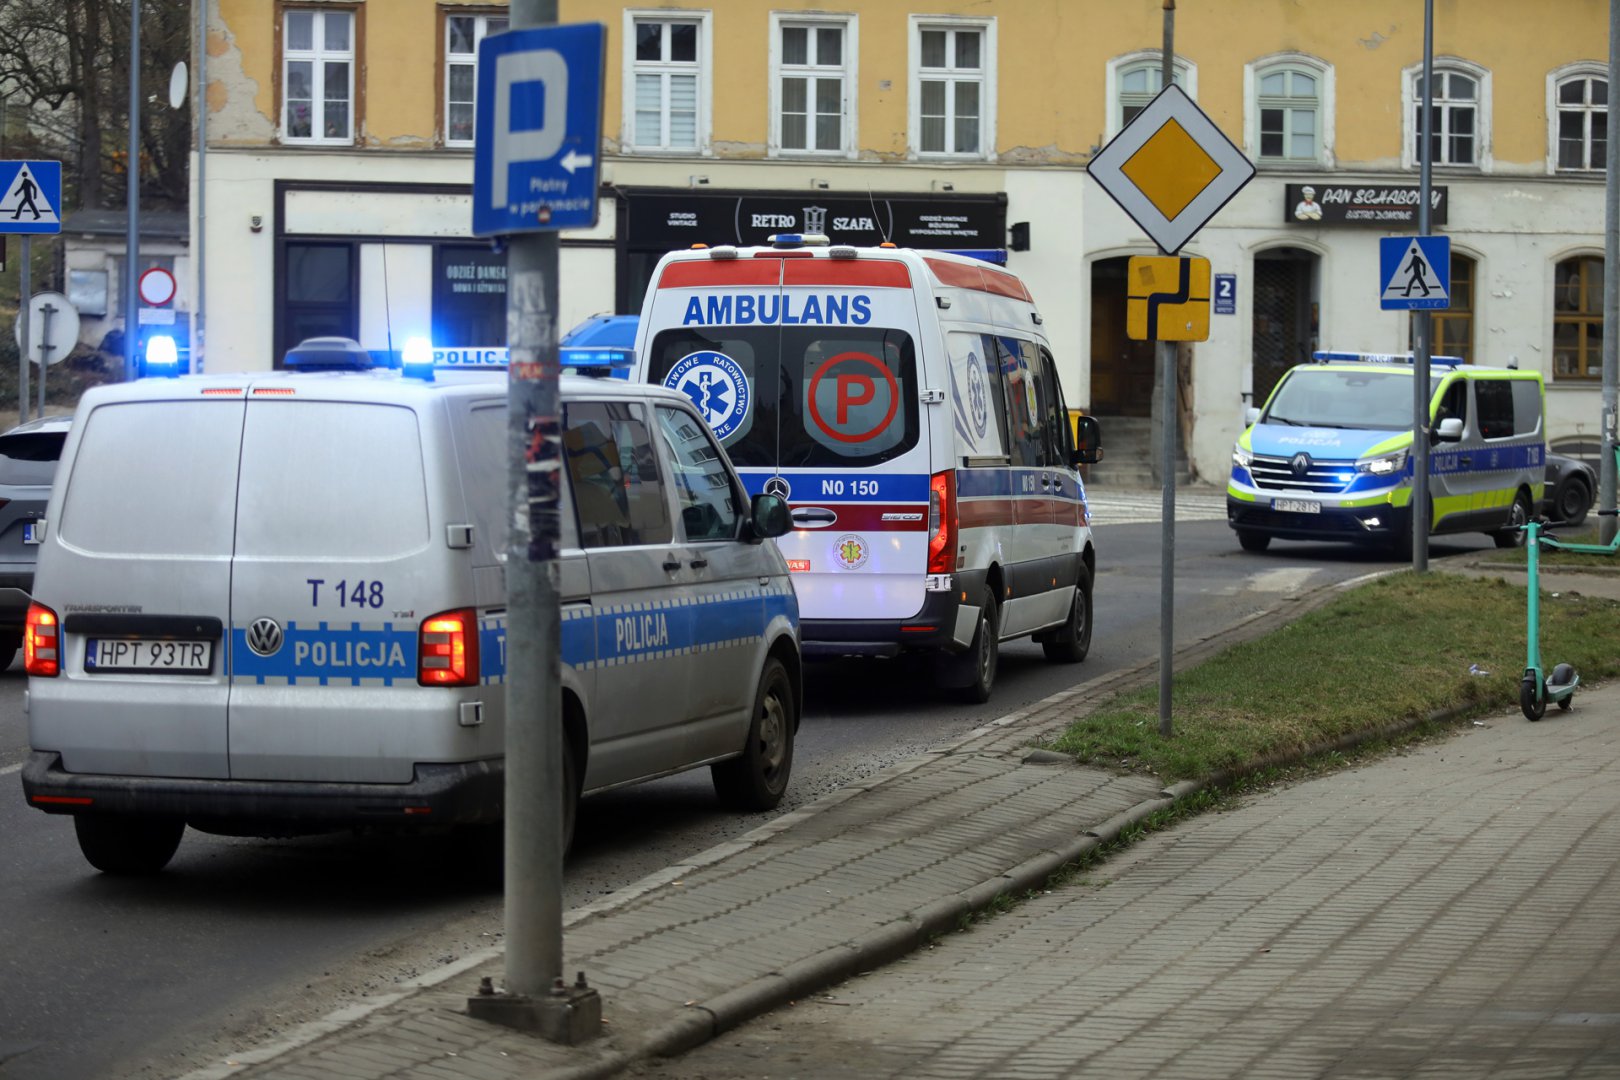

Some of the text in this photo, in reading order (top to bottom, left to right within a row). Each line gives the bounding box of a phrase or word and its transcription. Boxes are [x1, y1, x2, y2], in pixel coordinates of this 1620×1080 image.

[492, 49, 569, 209] P
[1322, 188, 1442, 210] PAN SCHABOY
[667, 219, 698, 227] VINTAGE
[751, 214, 796, 228] RETRO
[833, 217, 875, 231] SZAFA
[446, 261, 507, 279] ODZIEŻ DAMSK
[1220, 281, 1231, 297] 2
[683, 294, 872, 325] AMBULANS
[433, 351, 509, 364] POLICJ
[713, 356, 746, 415] RATOWNICTWO
[837, 374, 876, 425] P
[1278, 437, 1341, 448] POLICJA
[850, 480, 879, 495] 150
[307, 579, 384, 609] T 148
[615, 612, 669, 653] POLICJA
[100, 641, 205, 667] HPT 93TR
[295, 642, 406, 667] POLICJA
